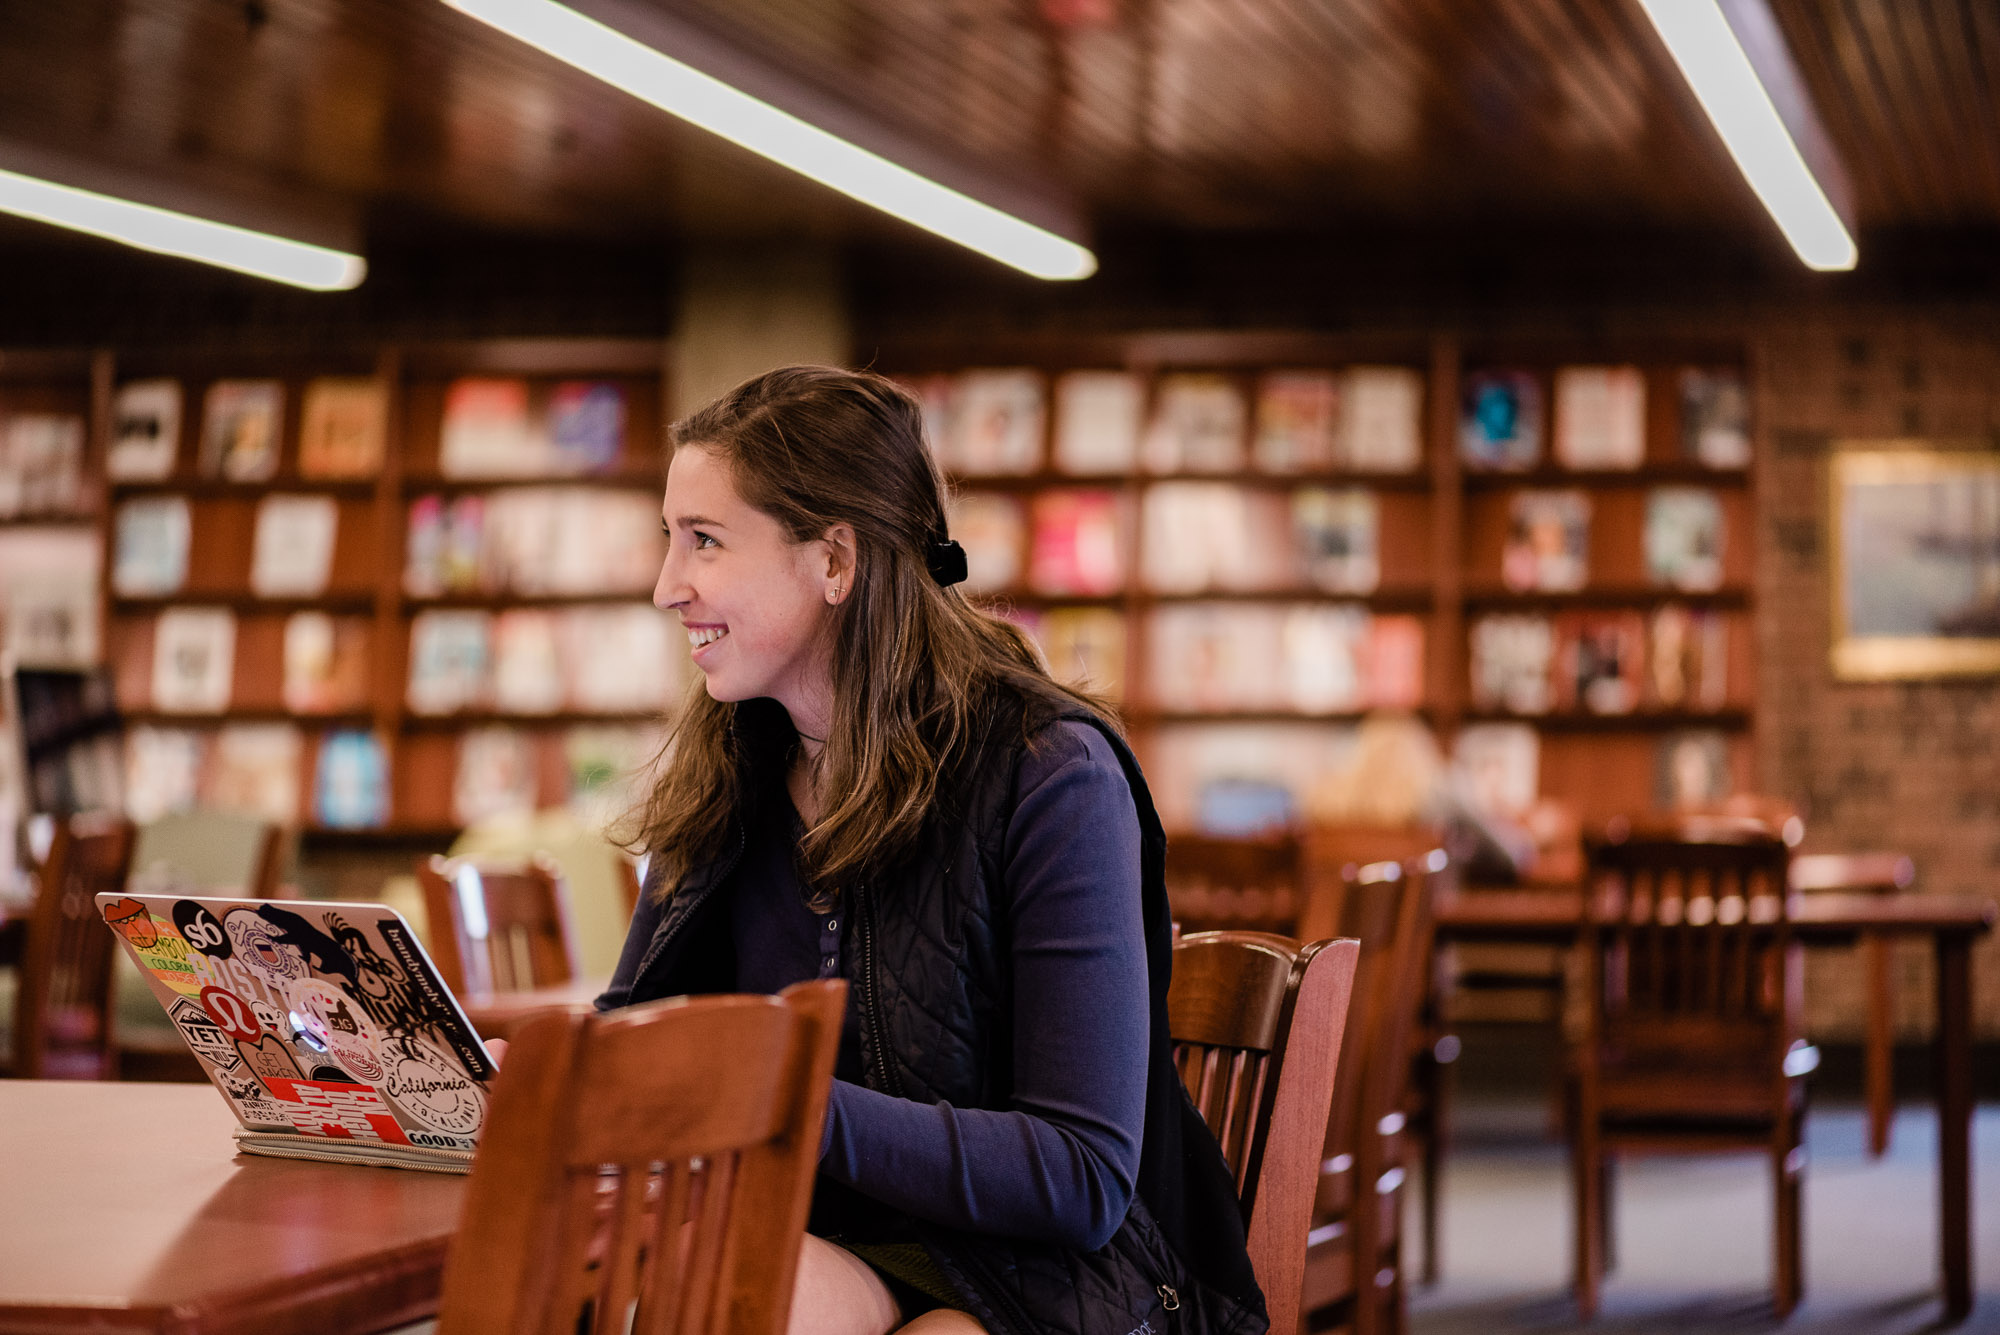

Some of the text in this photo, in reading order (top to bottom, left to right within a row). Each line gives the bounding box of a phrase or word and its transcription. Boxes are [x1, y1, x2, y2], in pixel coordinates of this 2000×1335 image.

[184, 909, 222, 949] s6
[152, 957, 201, 974] COLORAD
[256, 1052, 282, 1068] GET
[387, 1076, 471, 1098] California
[409, 1133, 457, 1147] GOOD
